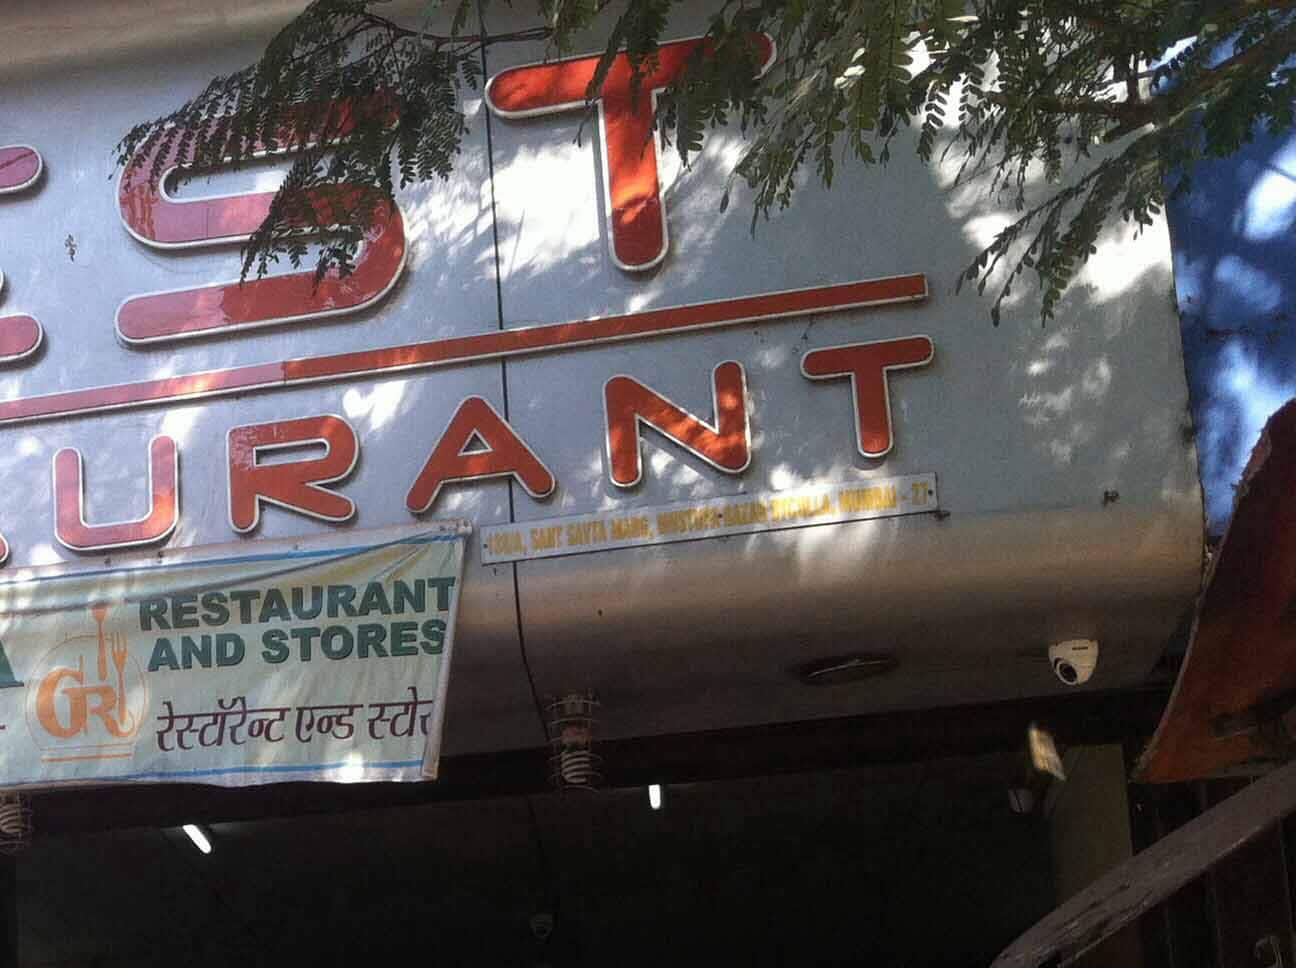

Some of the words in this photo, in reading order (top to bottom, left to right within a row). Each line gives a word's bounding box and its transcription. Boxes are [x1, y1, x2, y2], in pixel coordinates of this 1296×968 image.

[139, 576, 456, 632] RESTAURANT
[148, 632, 245, 672] AND
[261, 618, 448, 664] STORES
